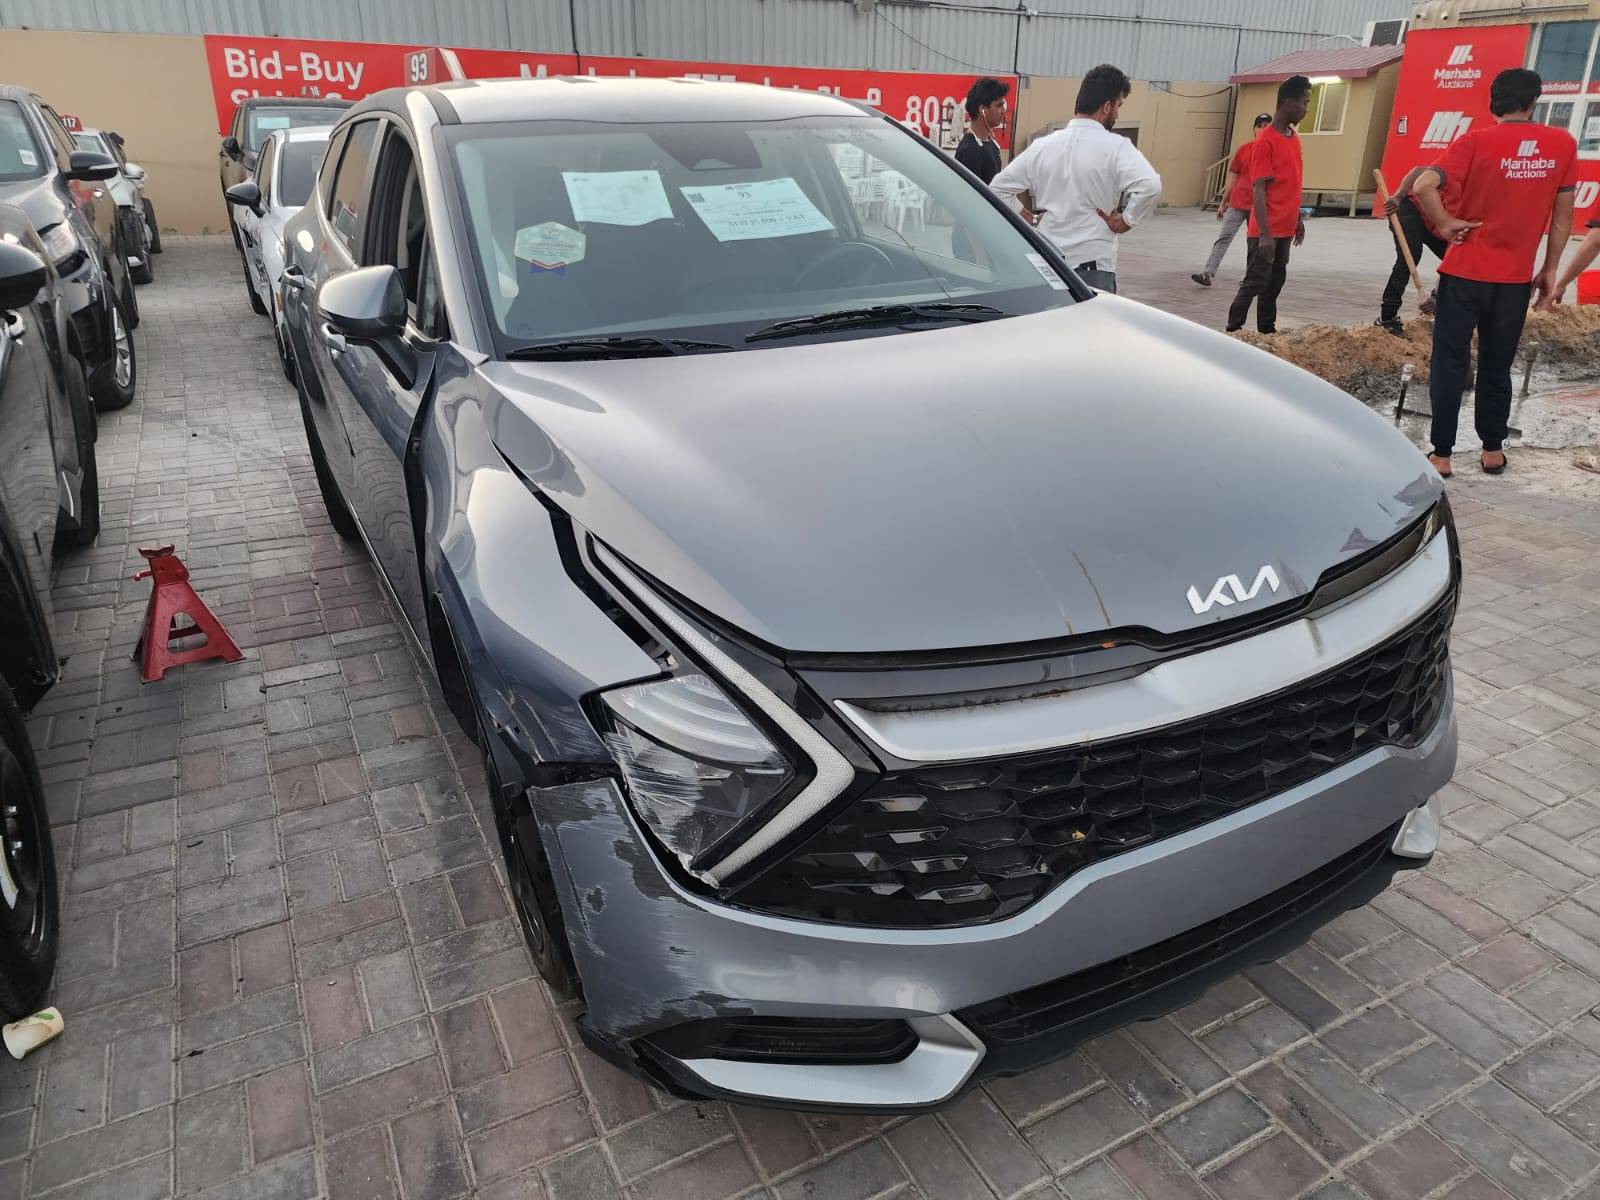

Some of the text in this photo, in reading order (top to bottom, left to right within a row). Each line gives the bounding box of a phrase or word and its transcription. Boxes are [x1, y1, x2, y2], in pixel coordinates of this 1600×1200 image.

[224, 47, 364, 90] Bid-Buy
[410, 53, 428, 81] 93
[1433, 67, 1481, 80] Marhaba
[1437, 80, 1474, 89] Auctions
[62, 117, 76, 128] 117
[1500, 157, 1556, 170] Marhaba
[1505, 169, 1547, 179] Auctions
[1186, 565, 1280, 615] KIA
